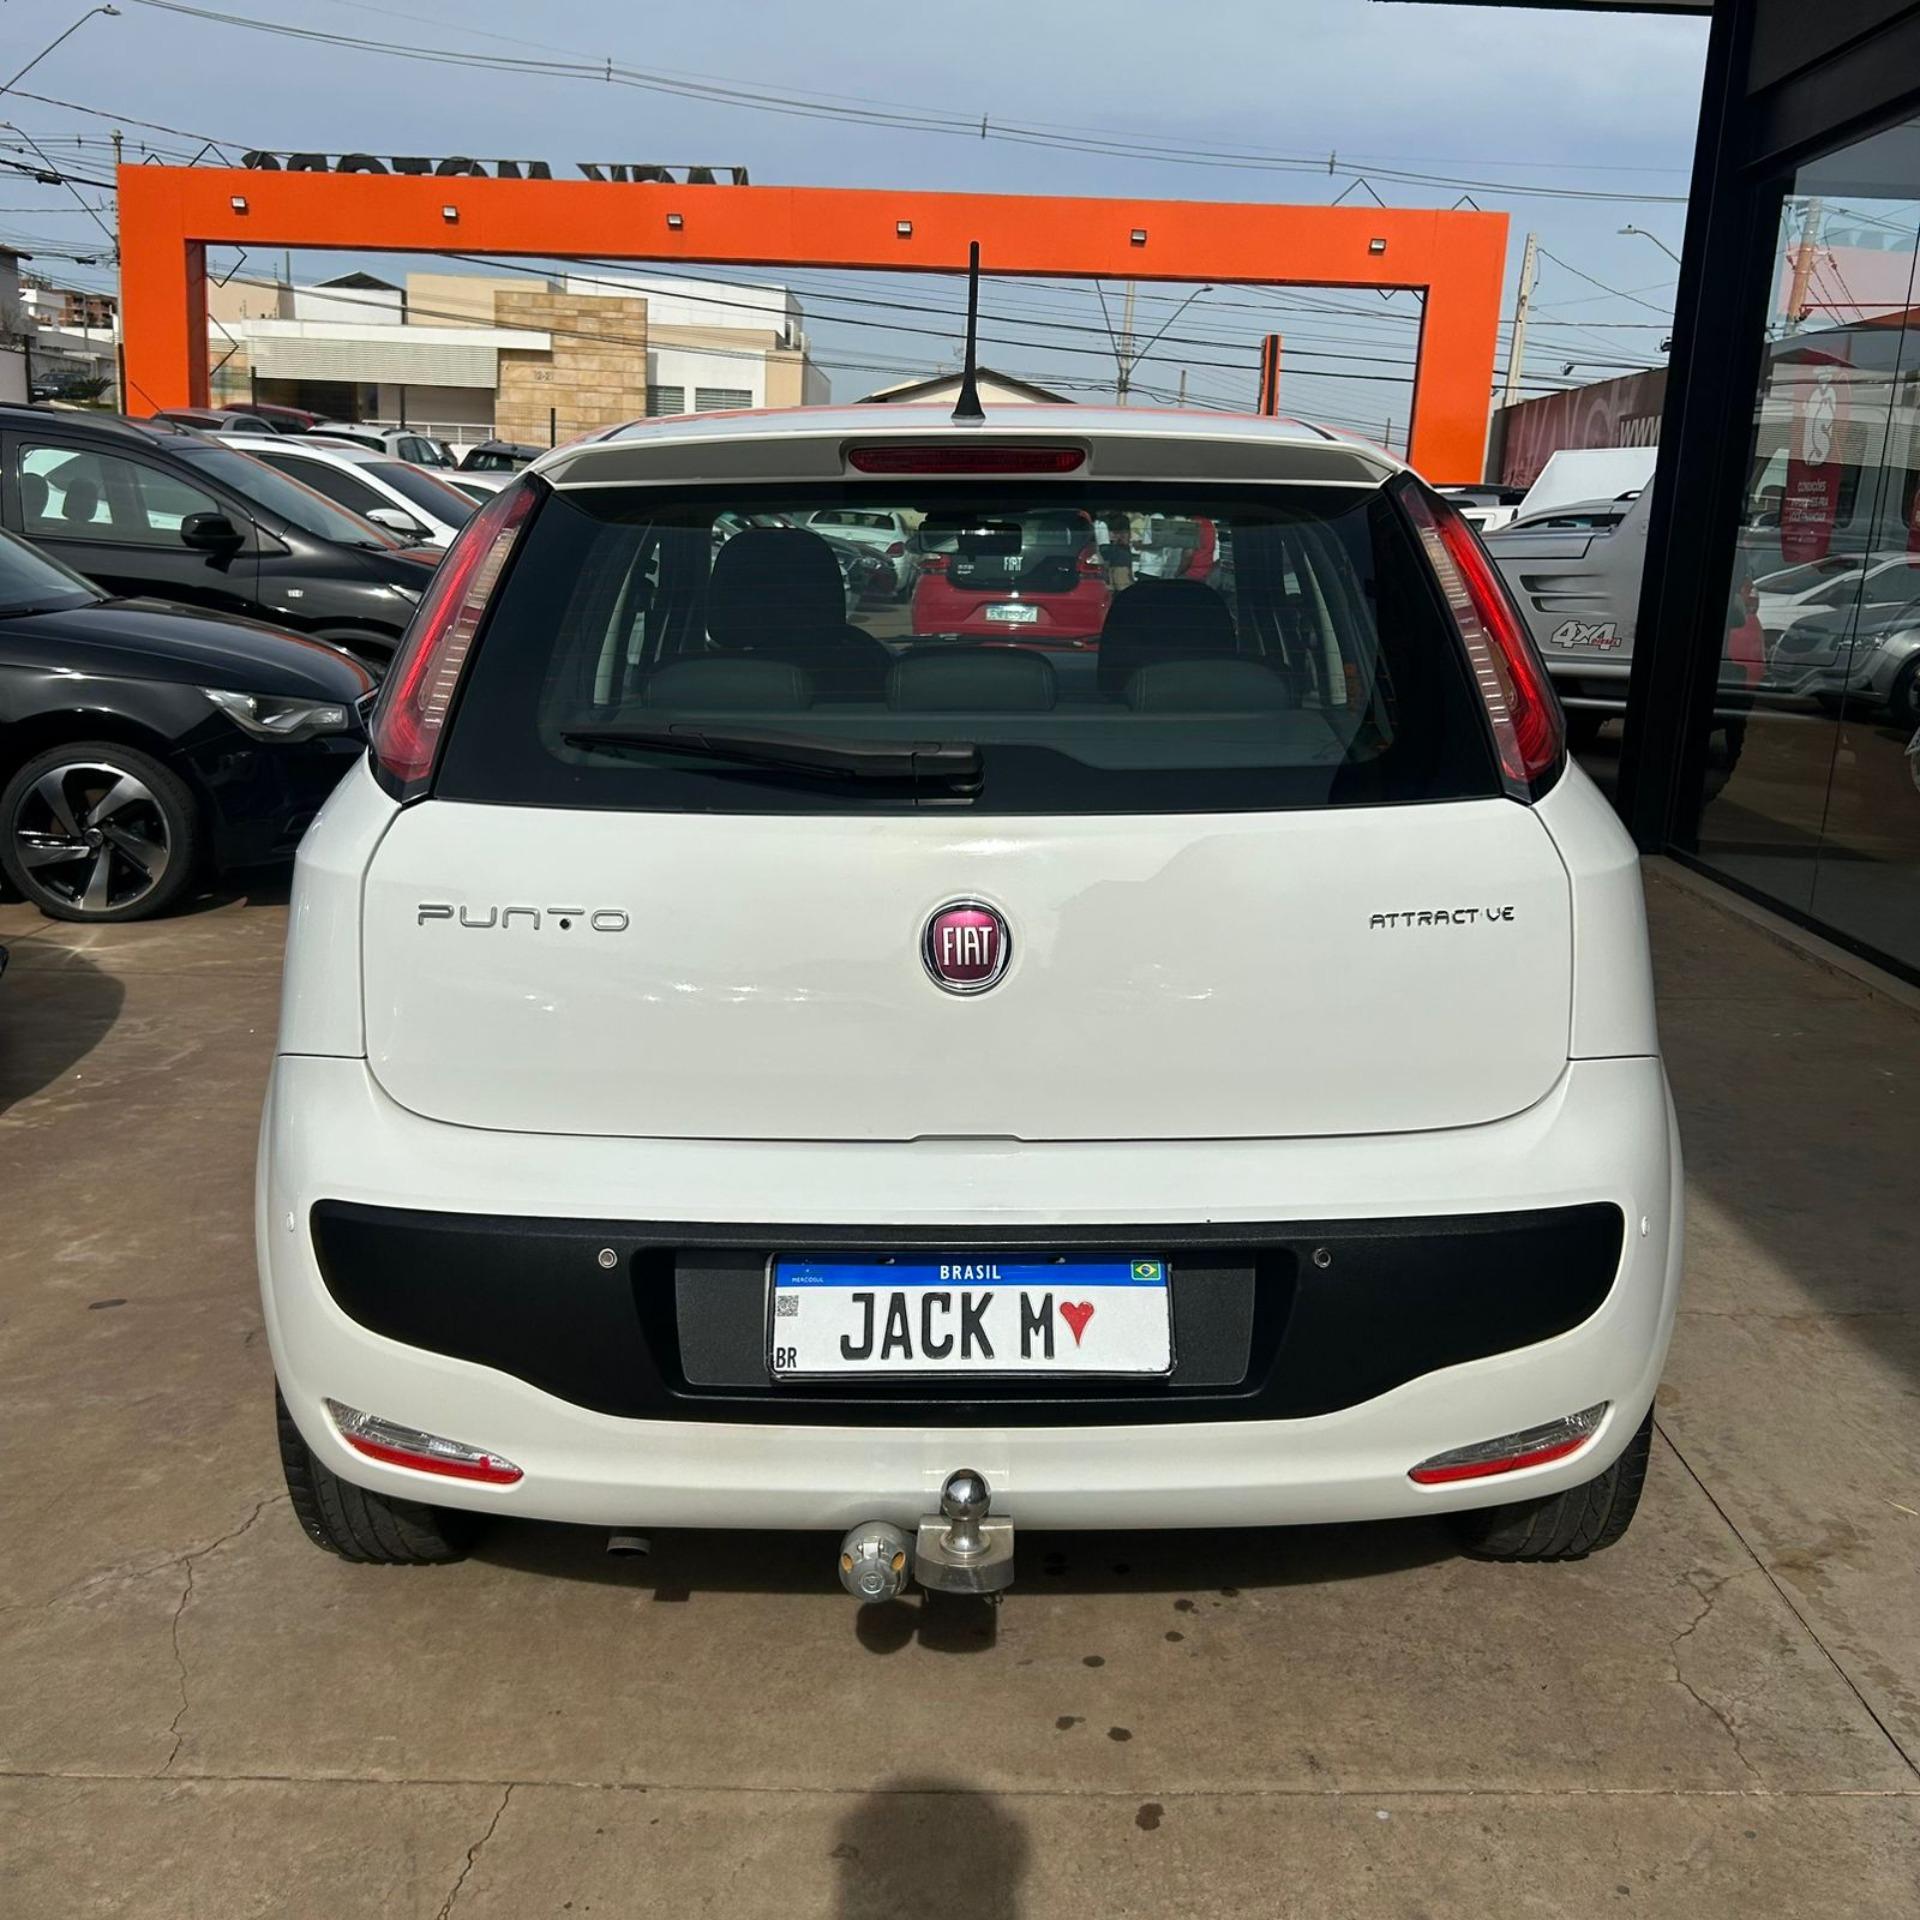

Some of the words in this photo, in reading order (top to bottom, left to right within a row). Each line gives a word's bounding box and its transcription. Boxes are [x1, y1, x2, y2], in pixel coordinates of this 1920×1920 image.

[1004, 556, 1024, 571] FIAT
[418, 904, 629, 932] PUNTO
[1370, 906, 1515, 930] ATTRACTVE
[942, 926, 993, 966] FIAT
[940, 1264, 1001, 1280] BRASIL
[840, 1291, 995, 1361] JACK
[775, 1346, 798, 1369] BR
